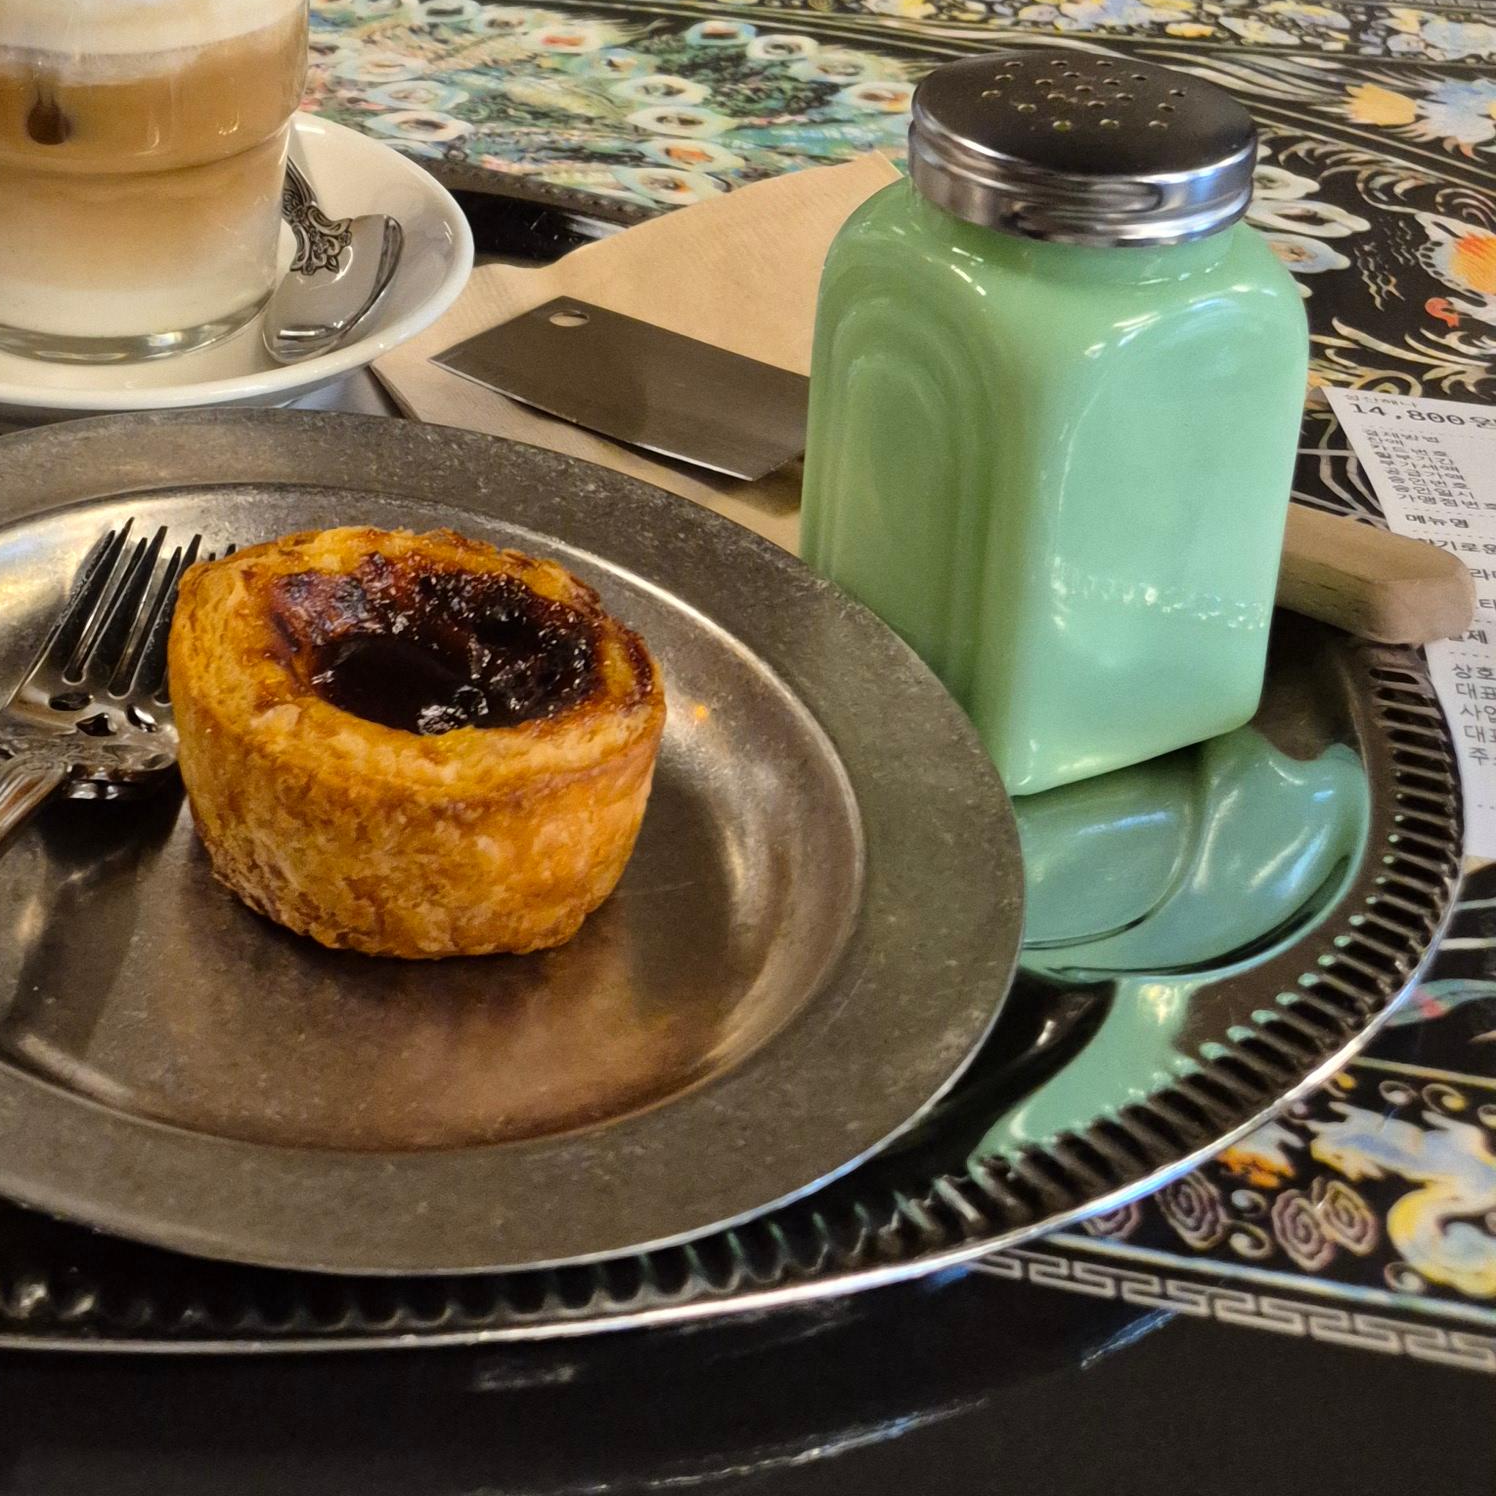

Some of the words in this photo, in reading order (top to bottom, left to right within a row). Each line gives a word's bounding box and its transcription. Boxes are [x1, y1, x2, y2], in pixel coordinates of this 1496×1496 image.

[1374, 451, 1454, 465] 할부기간
[1379, 460, 1460, 473] 부가세액
[1388, 476, 1471, 490] 승인번호
[1392, 485, 1475, 499] 승인일시
[1405, 513, 1470, 529] 메뉴명
